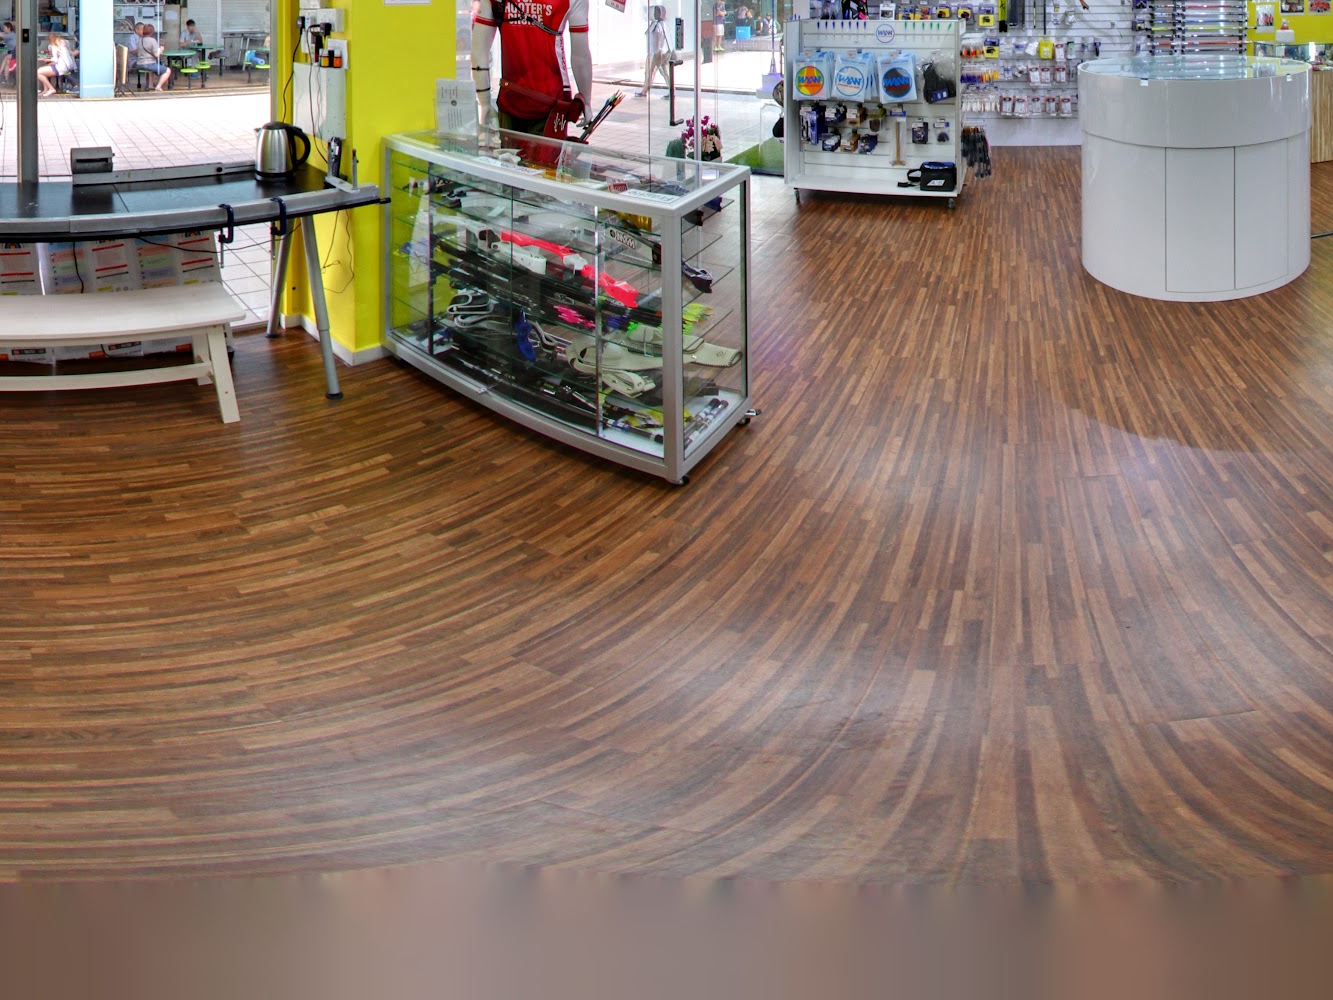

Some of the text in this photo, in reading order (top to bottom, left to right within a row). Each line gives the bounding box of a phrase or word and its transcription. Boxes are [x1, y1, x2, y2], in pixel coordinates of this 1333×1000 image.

[798, 76, 821, 84] W&W
[837, 74, 861, 86] W&W
[884, 77, 910, 86] W&W
